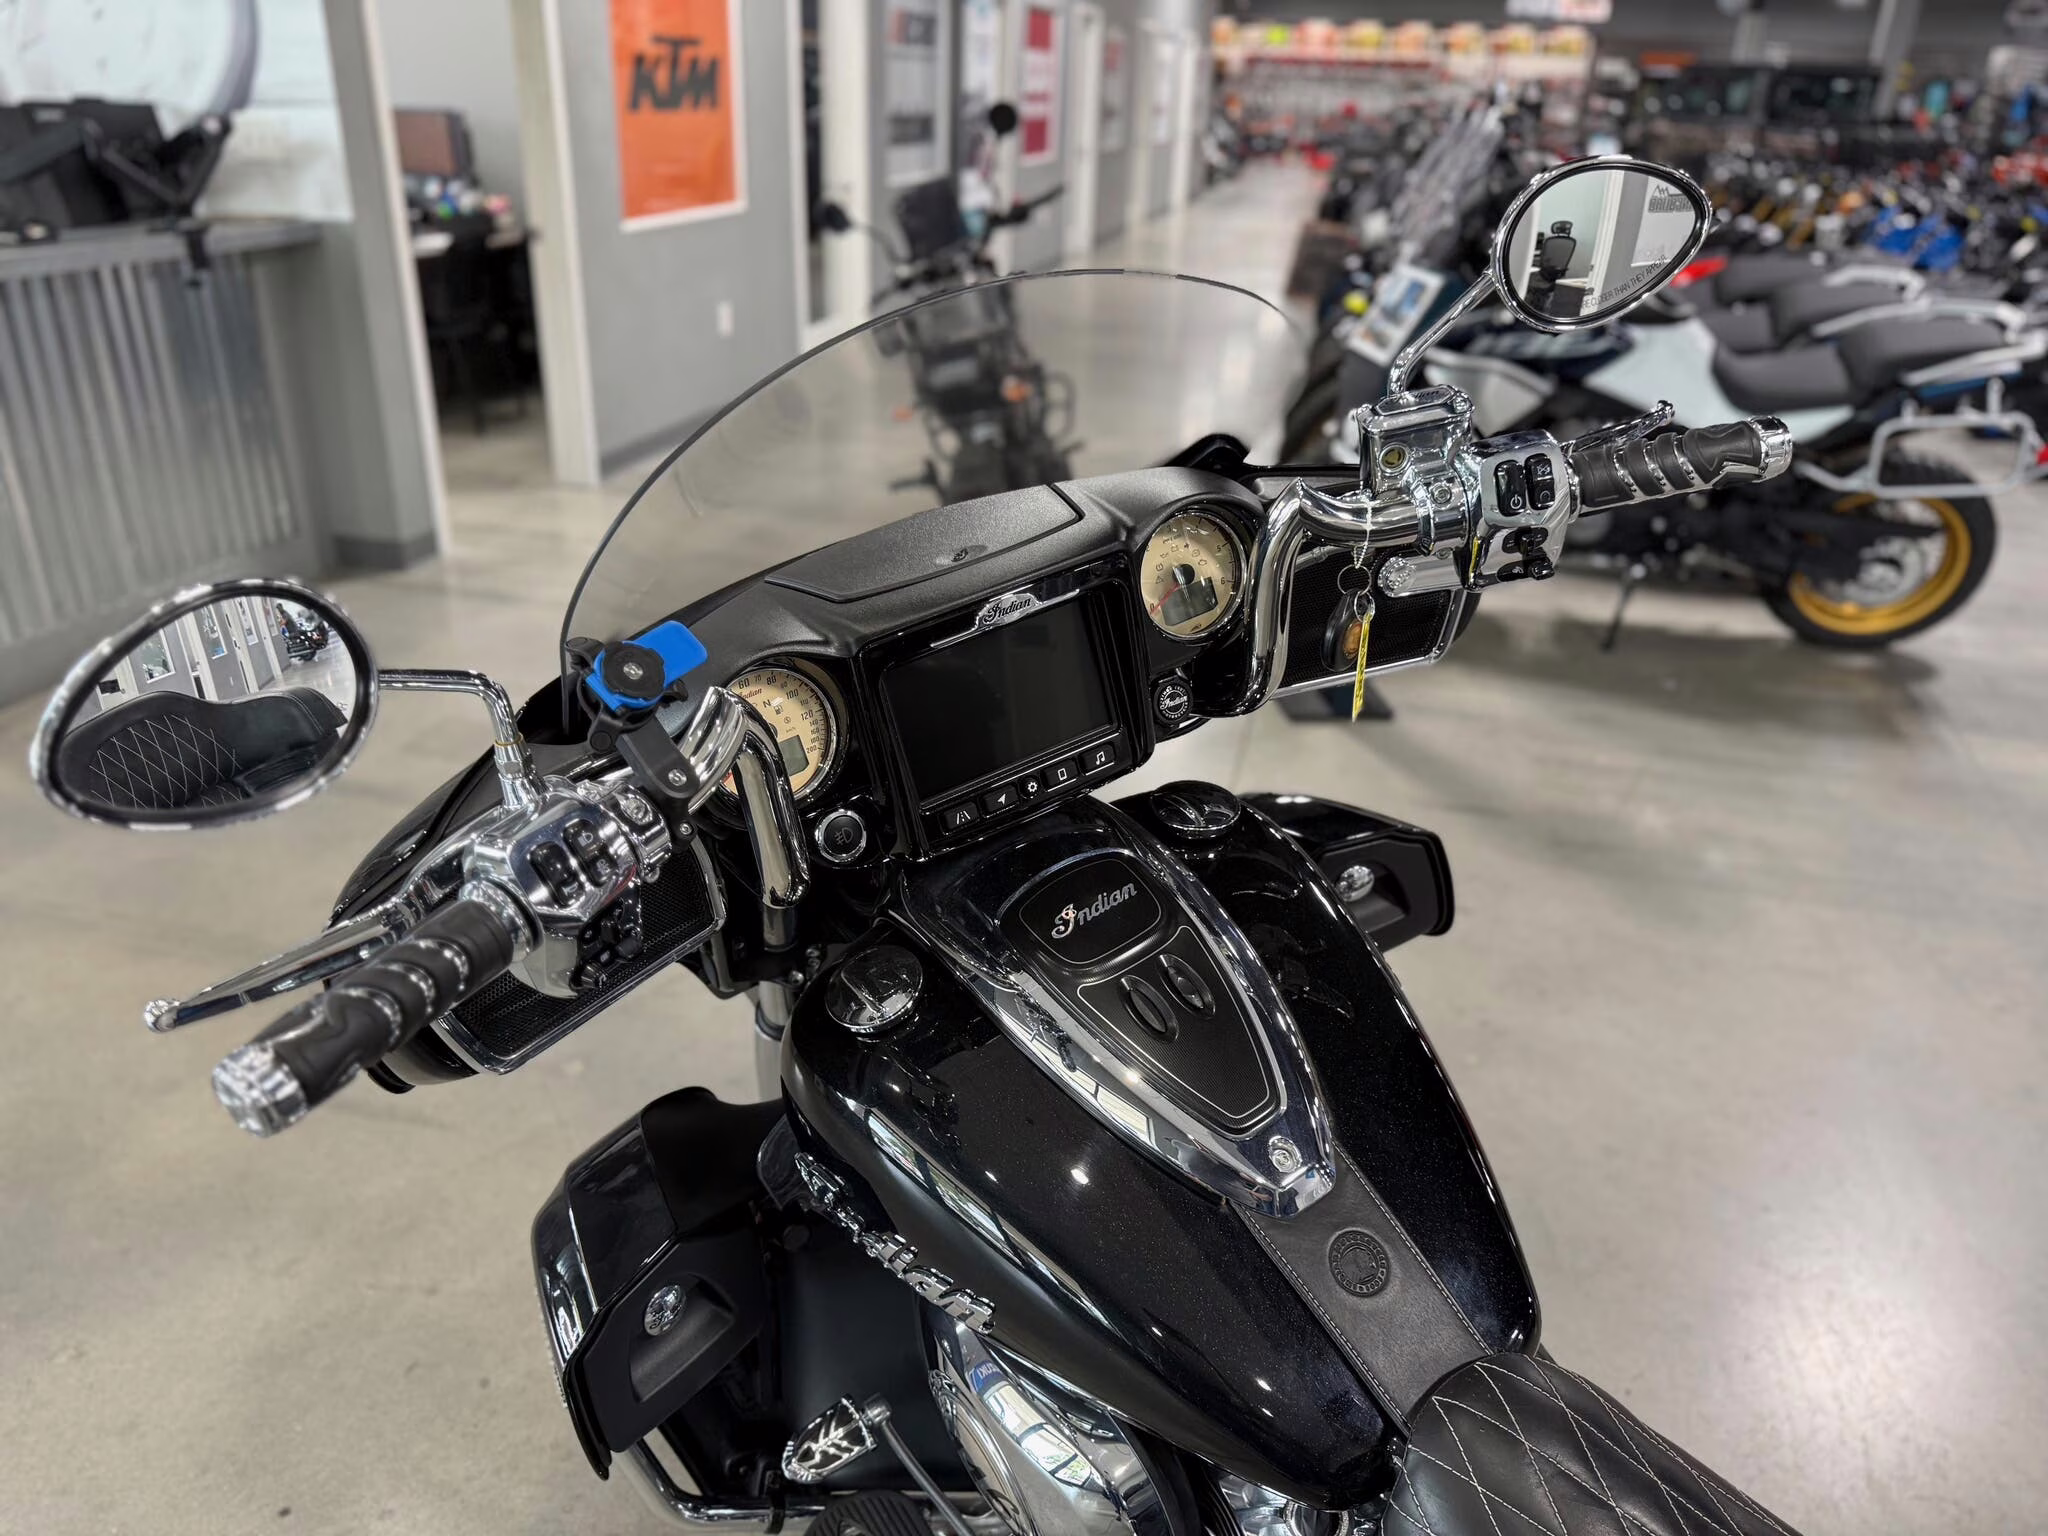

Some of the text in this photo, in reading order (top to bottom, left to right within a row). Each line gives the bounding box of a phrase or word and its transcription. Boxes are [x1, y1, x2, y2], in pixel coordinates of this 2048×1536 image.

[629, 35, 719, 112] KTM
[1613, 282, 1630, 297] THAN
[1630, 273, 1645, 287] THEY
[1645, 254, 1667, 275] APPEAR
[1220, 577, 1226, 585] 6
[982, 598, 1031, 624] Indian
[738, 677, 750, 689] 60
[786, 688, 799, 700] 100
[763, 699, 772, 708] N
[801, 709, 813, 721] 120
[1051, 883, 1138, 939] Indian
